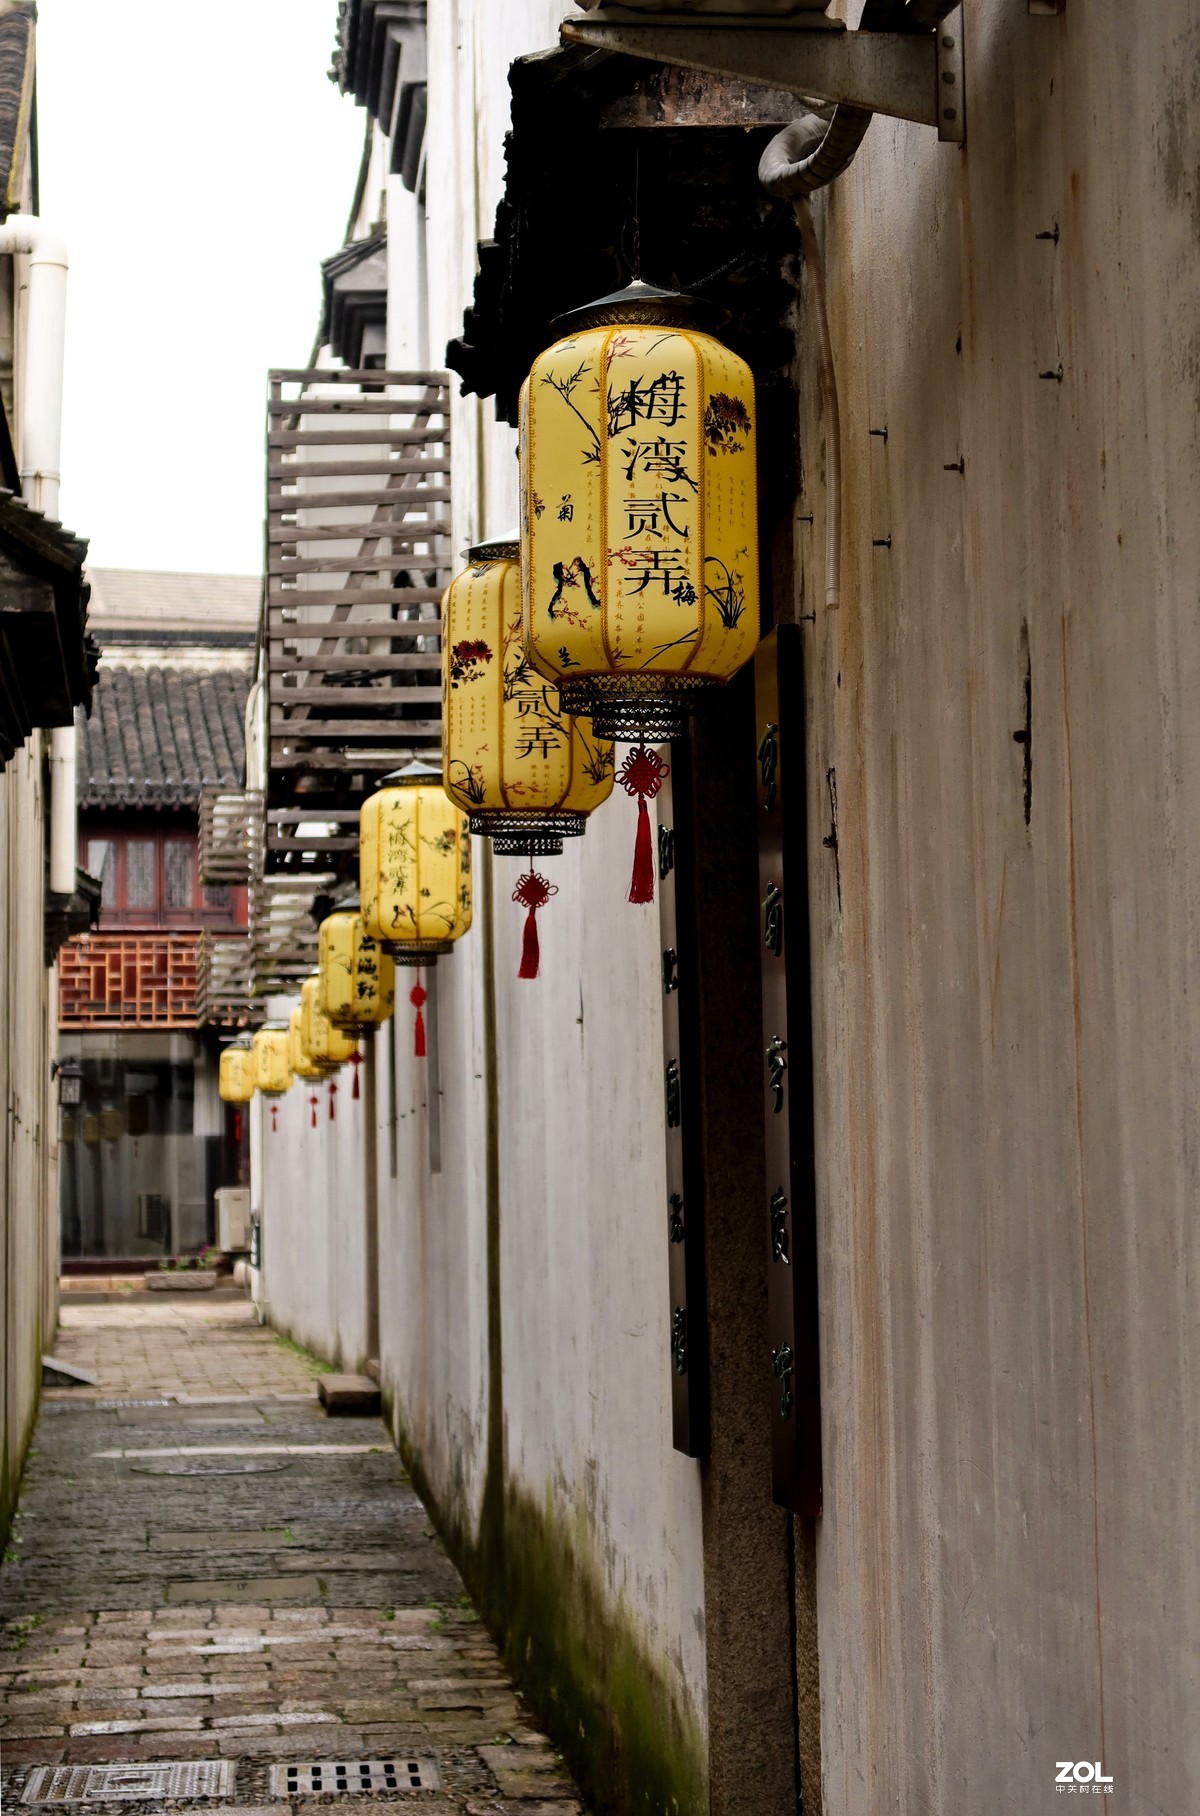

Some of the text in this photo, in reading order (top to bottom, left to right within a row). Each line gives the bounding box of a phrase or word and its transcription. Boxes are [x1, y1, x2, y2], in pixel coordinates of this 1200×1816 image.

[556, 495, 574, 522] 菊
[672, 580, 700, 608] 梅
[513, 646, 562, 761] 贰弄
